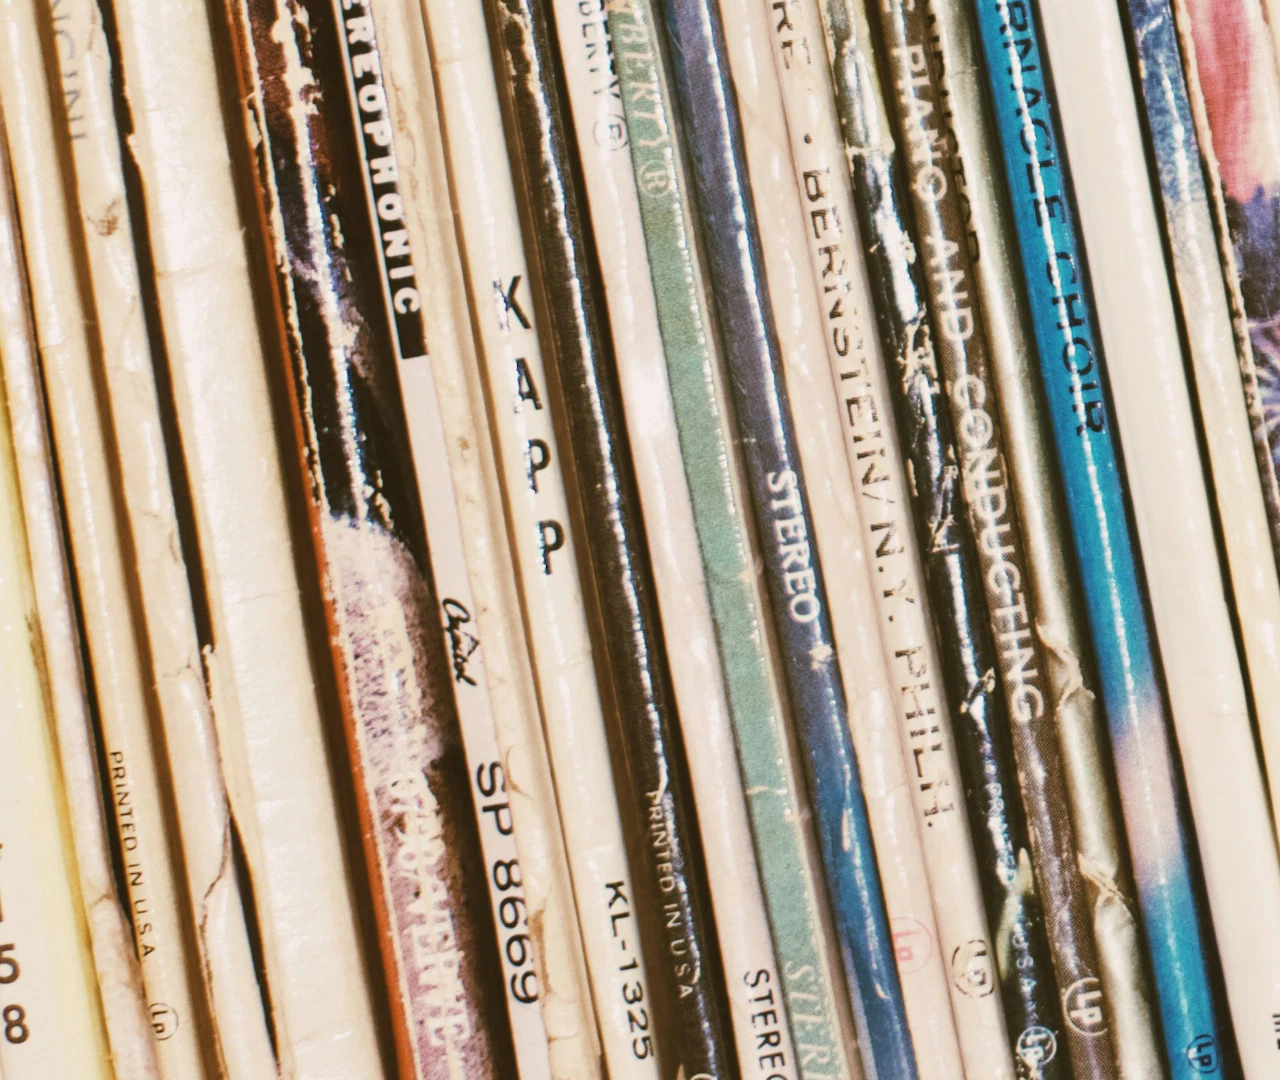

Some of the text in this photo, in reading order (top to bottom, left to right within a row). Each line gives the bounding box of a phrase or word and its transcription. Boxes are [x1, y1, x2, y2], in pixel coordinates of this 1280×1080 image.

[890, 43, 950, 205] PIANO
[925, 231, 976, 345] AND
[1042, 252, 1104, 438] CHOIR
[490, 274, 573, 576] KAPP
[763, 467, 822, 626] STEREO
[949, 370, 1046, 726] CONDUCTING
[105, 750, 138, 853] PRINTED
[124, 861, 144, 889] IN
[472, 760, 541, 1009] SP 8669
[640, 789, 677, 896] PRINTED
[661, 902, 683, 929] IN
[600, 879, 656, 1063] KL-1325
